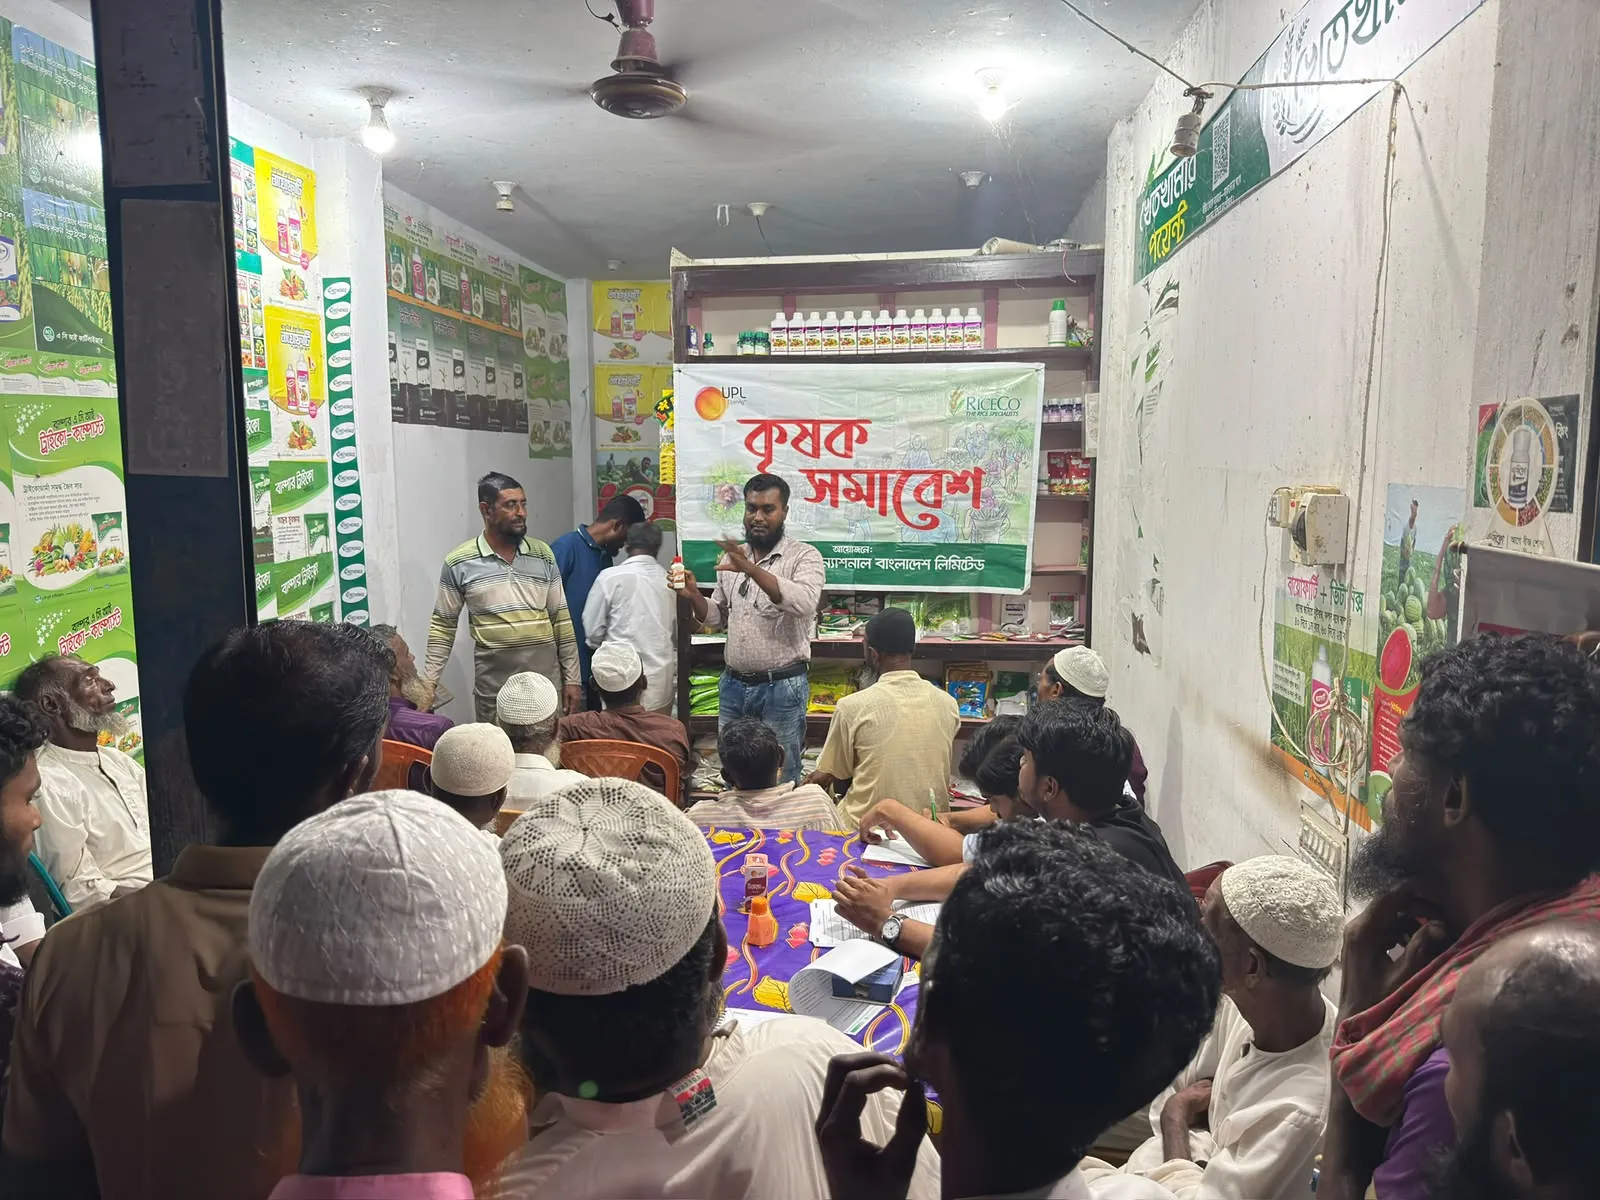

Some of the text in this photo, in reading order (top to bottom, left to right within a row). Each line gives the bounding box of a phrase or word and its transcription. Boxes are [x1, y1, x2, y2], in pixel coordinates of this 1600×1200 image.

[722, 386, 746, 399] UPL
[736, 418, 872, 474] কৃষক
[798, 466, 987, 531] সমাবেশ
[823, 555, 985, 571] ন্যাশনাল বাংলাদেশ লিমিটেড
